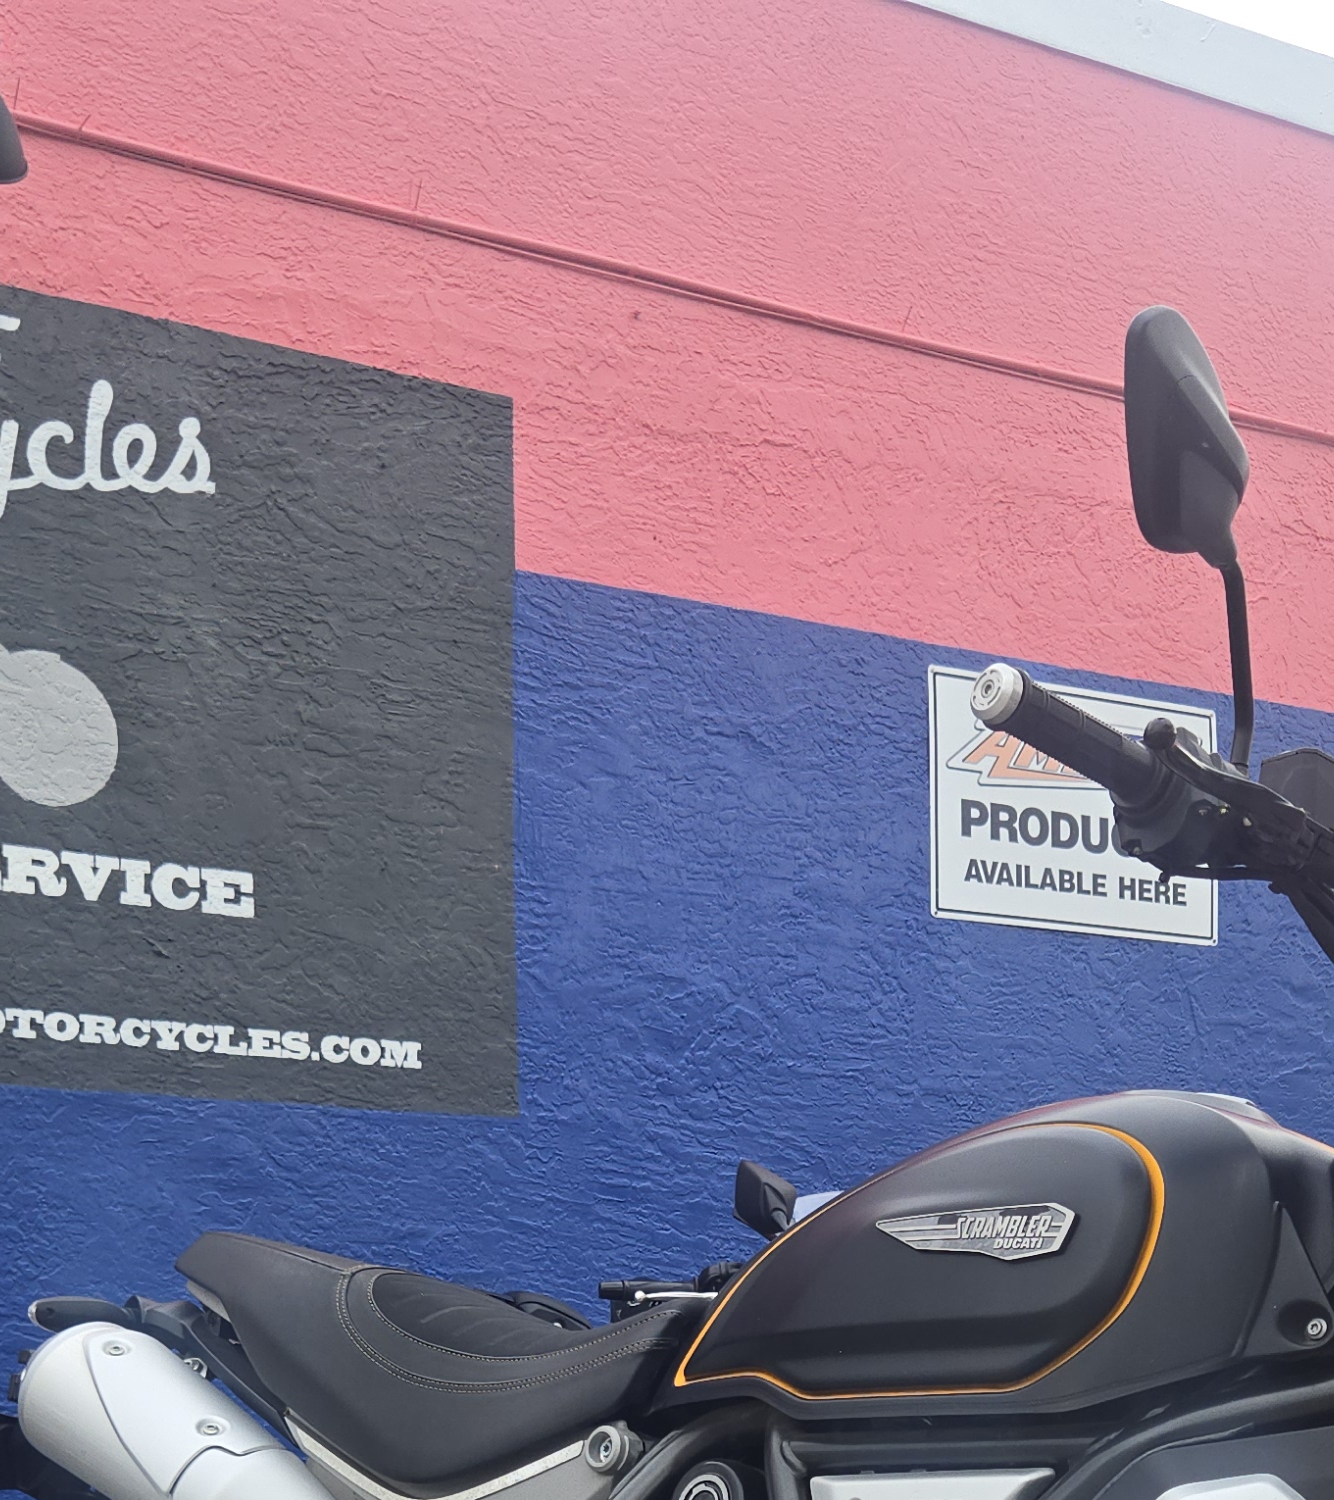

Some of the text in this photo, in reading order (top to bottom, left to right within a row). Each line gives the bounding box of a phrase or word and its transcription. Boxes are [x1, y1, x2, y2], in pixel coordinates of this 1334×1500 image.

[961, 798, 1130, 858] PRODU
[964, 858, 1187, 907] AVAILABLE HERE
[956, 1215, 1052, 1239] SCRAMBLER
[993, 1238, 1044, 1249] DUCATI
